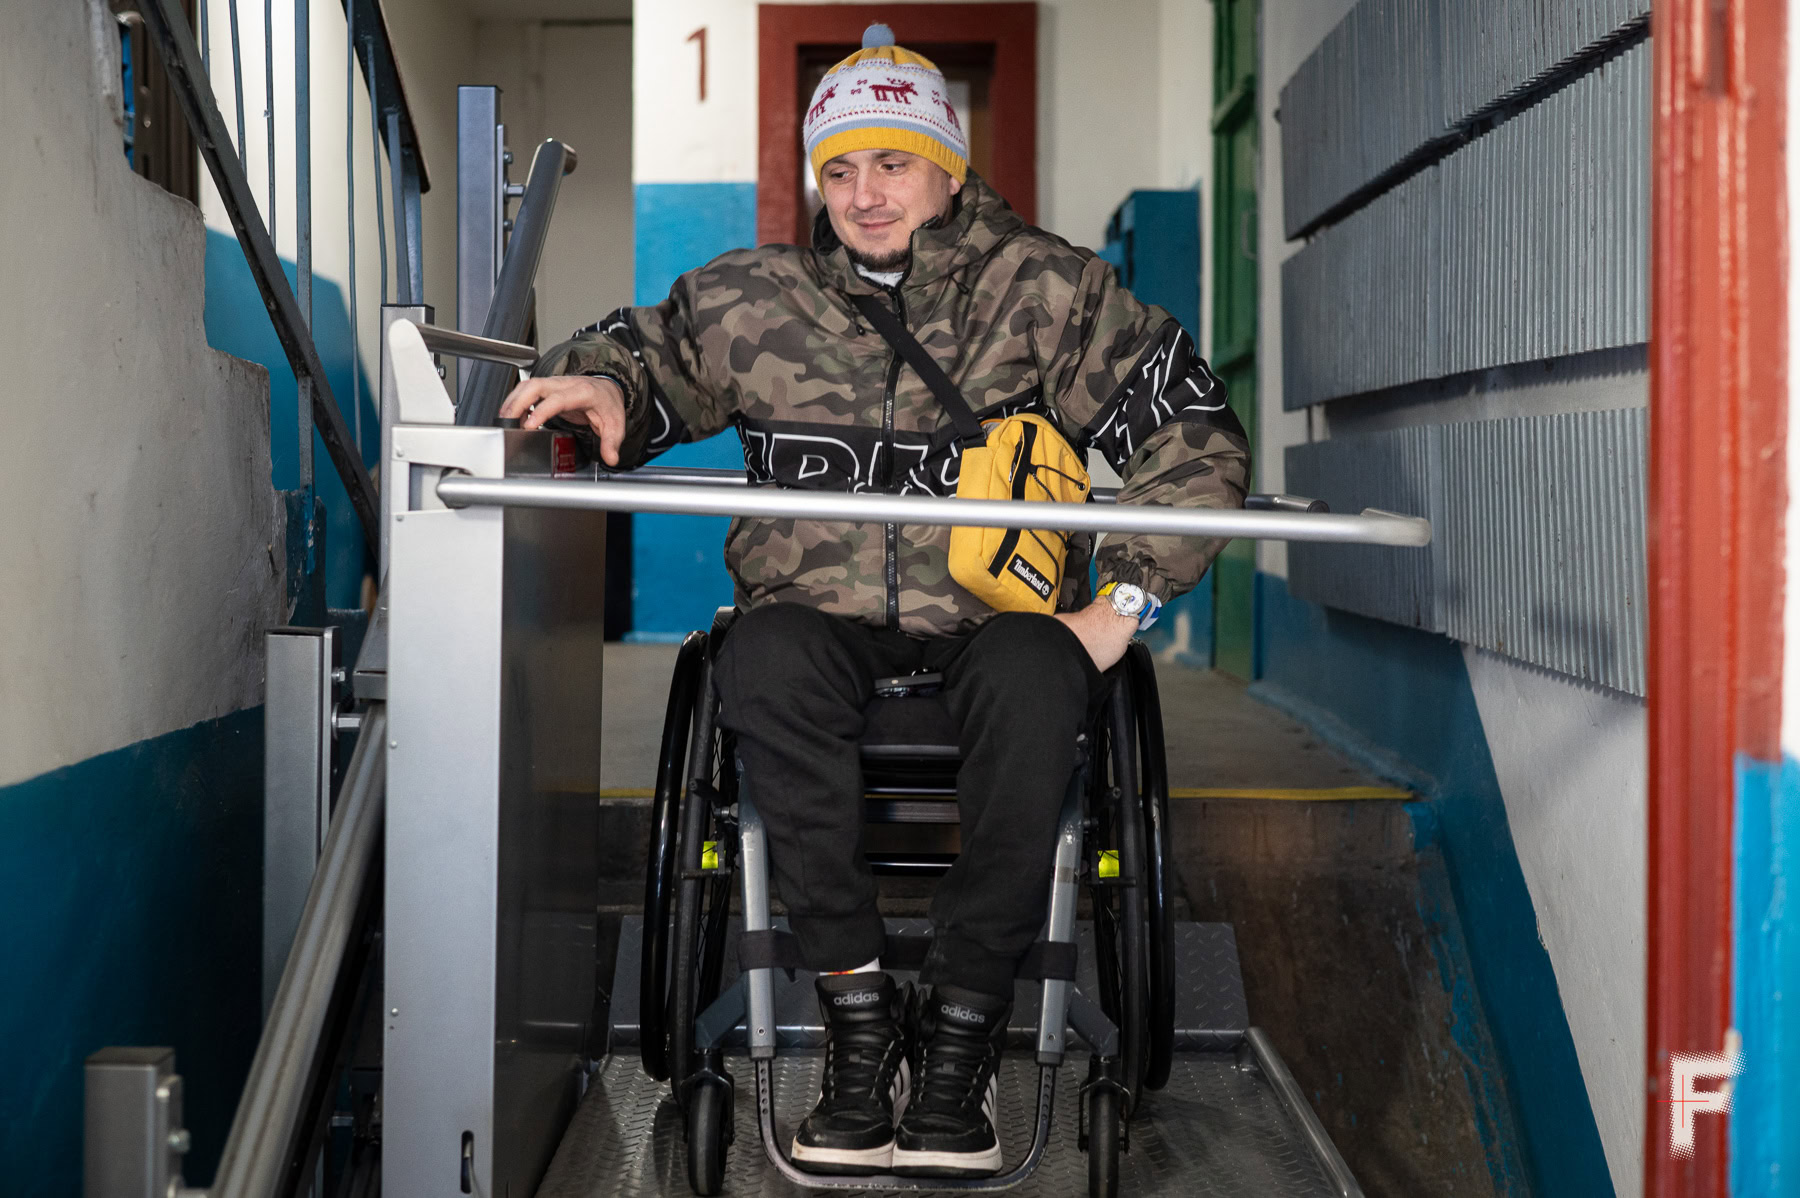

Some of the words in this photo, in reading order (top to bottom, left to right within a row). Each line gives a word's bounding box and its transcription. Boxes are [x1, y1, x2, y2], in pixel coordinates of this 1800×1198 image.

[686, 27, 707, 102] 1
[1013, 558, 1045, 591] Timberland
[834, 992, 880, 1006] adidas
[941, 1004, 985, 1024] adidas
